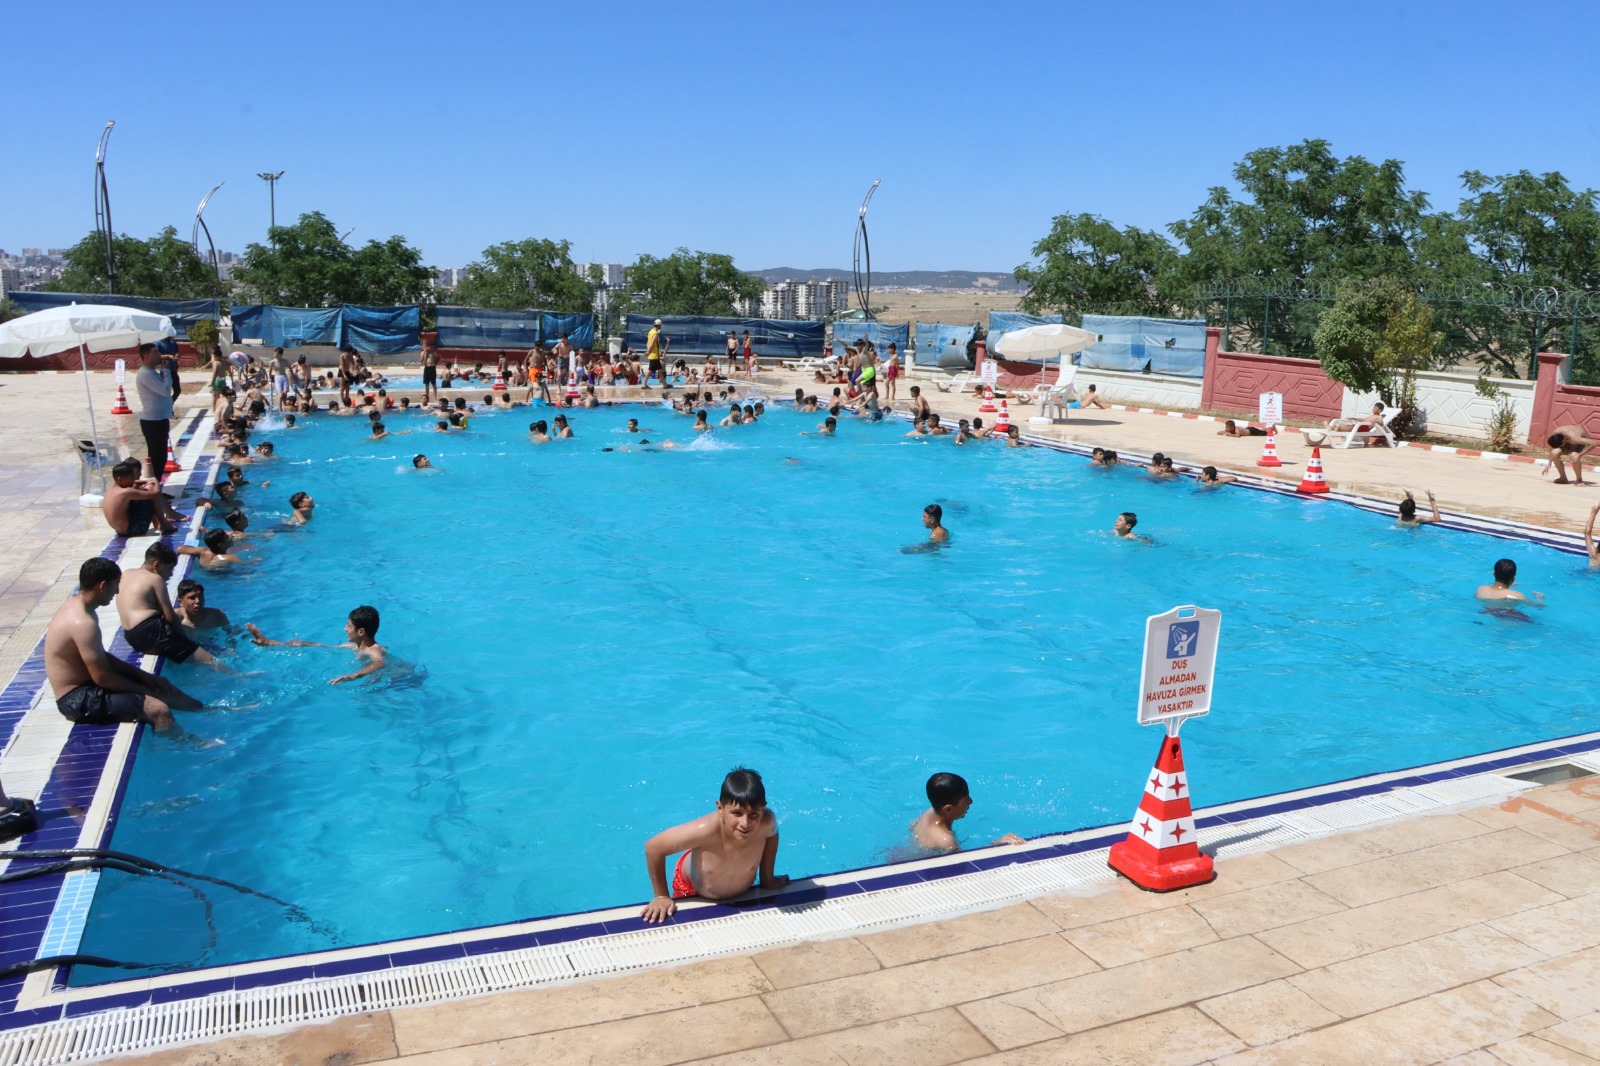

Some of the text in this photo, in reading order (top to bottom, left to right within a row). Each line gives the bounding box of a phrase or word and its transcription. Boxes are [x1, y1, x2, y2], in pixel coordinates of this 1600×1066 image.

[1172, 660, 1187, 670] DUŞ
[1159, 672, 1196, 686] ALMADAN
[1146, 684, 1207, 702] HAVUZA GİRMEK
[1157, 700, 1194, 714] YASAKTIR
